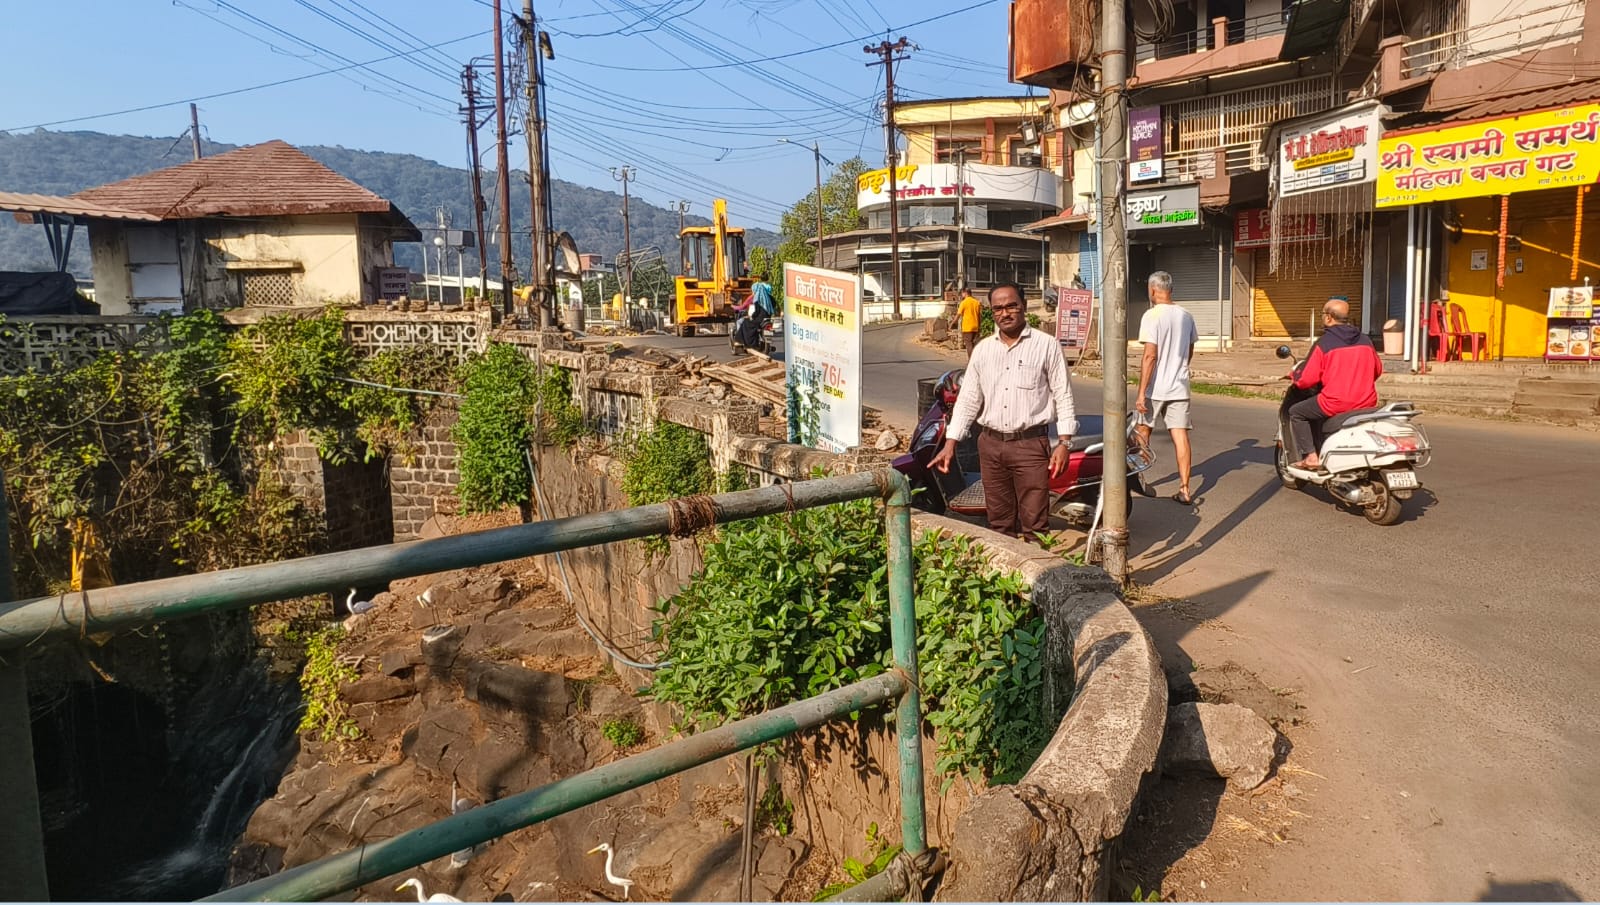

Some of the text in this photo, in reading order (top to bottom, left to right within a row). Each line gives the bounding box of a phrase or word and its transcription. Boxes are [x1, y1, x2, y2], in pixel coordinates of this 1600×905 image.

[1381, 143, 1414, 170] श्री
[1423, 129, 1505, 164] स्वामी
[1515, 112, 1600, 150] समर्थ
[1395, 165, 1464, 190] महिला
[1536, 152, 1576, 172] गट
[819, 281, 844, 305] सेल्स
[792, 322, 819, 341] Big and
[823, 384, 844, 399] PER DAY
